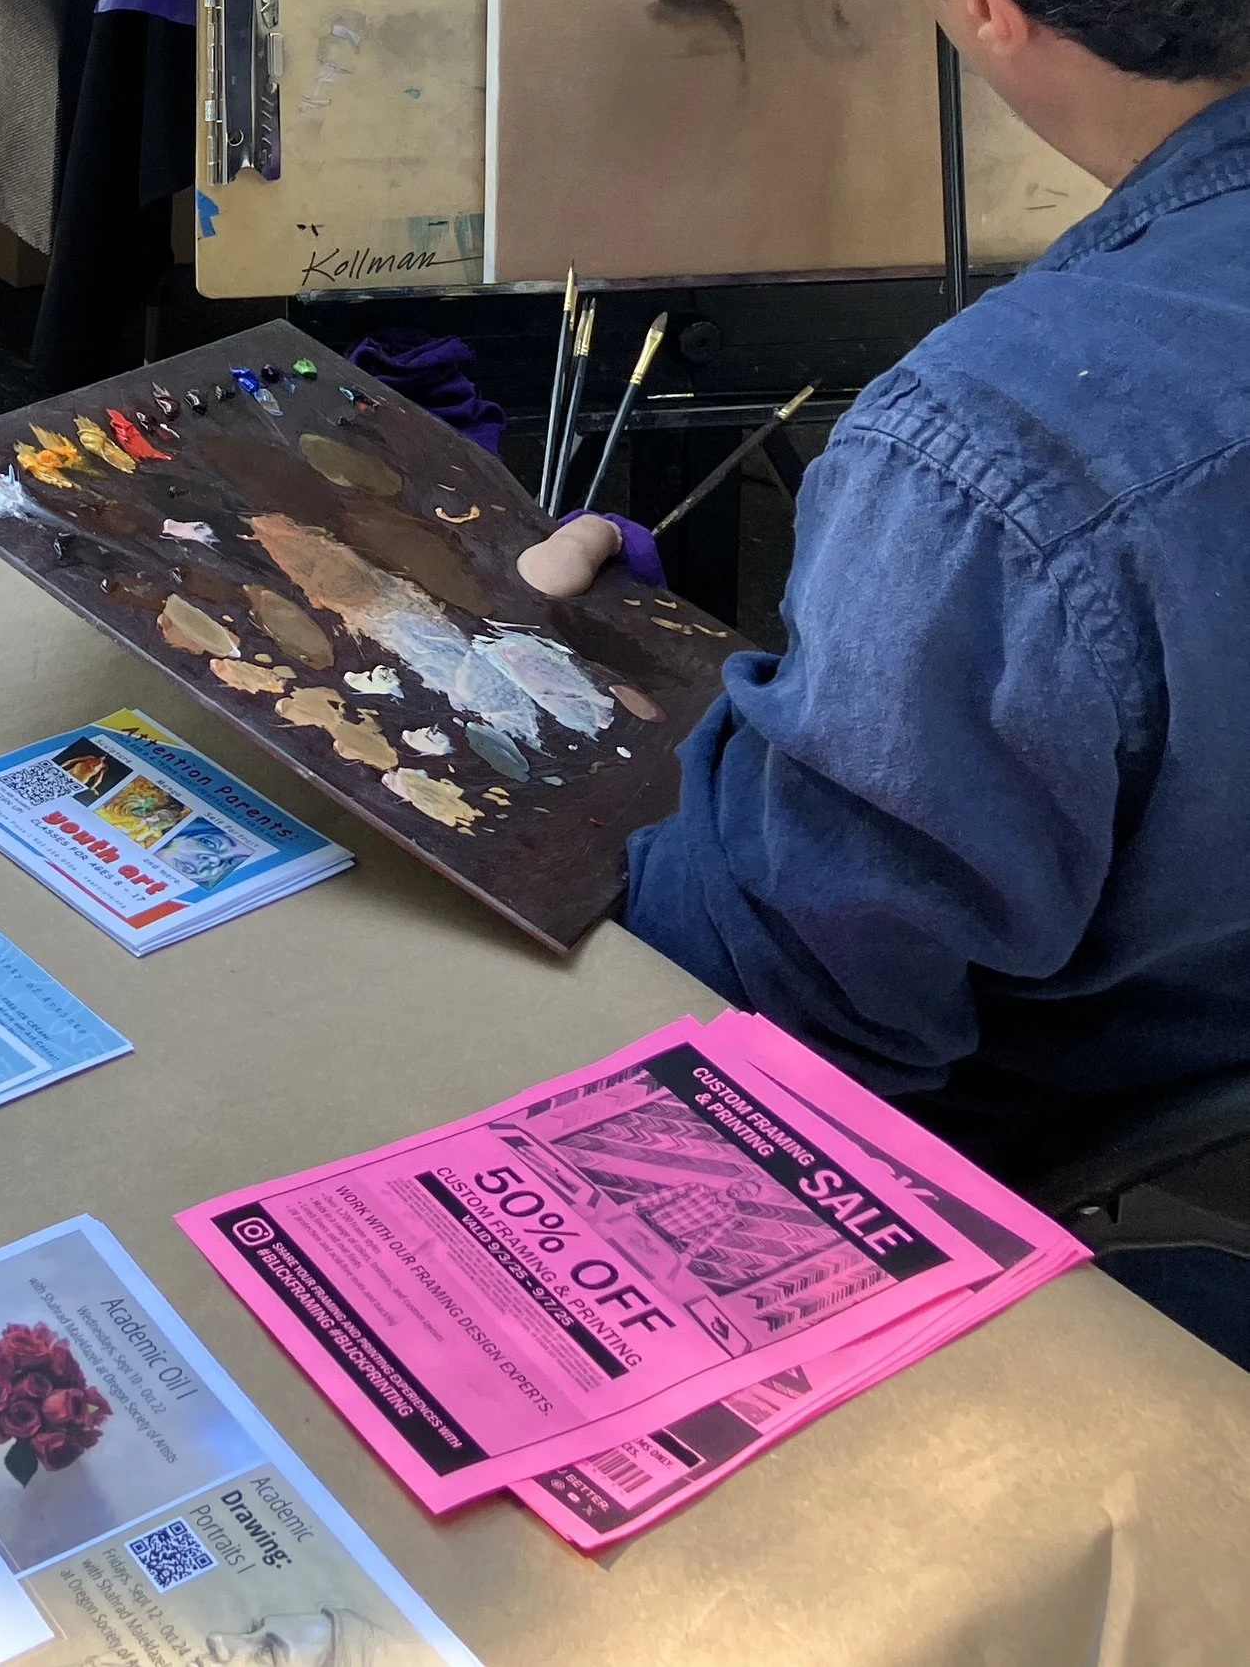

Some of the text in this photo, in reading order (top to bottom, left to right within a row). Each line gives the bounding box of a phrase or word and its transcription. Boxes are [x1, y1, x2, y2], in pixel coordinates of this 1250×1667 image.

[120, 725, 217, 785] Attention
[154, 779, 183, 797] Manga
[37, 808, 170, 896] youth art
[203, 812, 224, 824] Self
[29, 818, 70, 846] CLASSES
[67, 846, 89, 860] FOR
[87, 861, 115, 879] AGES
[130, 893, 145, 902] 17
[689, 1066, 817, 1167] CUSTOM FRAMING
[691, 1090, 778, 1157] & PRINTING
[468, 1161, 586, 1256] 50%
[562, 1254, 675, 1342] OFF
[791, 1167, 915, 1256] SALE
[27, 1276, 47, 1294] with
[334, 1185, 555, 1416] WORK WITH OUR FRAMING DESIGN EXPERTS.
[433, 1166, 644, 1367] CUSTOM FRAMING & PRINTING
[457, 1214, 576, 1327] VALID 9/3/25 9/7/25
[40, 1292, 71, 1324] Shahrad
[100, 1294, 172, 1368] Academic
[155, 1365, 190, 1391] Oil
[255, 1246, 415, 1417] #BLICKFRAMING #BLICKPRINTING
[270, 1241, 462, 1448] SHARE YOUR FRAMING AND PRINTING EXPERIENCES WITH
[71, 1305, 167, 1414] Wednesdays, Sept 10 Oct 22
[95, 1363, 110, 1375] at
[100, 1373, 132, 1404] Oregon
[122, 1402, 153, 1431] Society
[145, 1428, 160, 1439] of
[153, 1438, 179, 1463] Artists
[187, 1504, 251, 1566] Portraits
[214, 1489, 296, 1571] Drawing:
[249, 1475, 318, 1542] Academic
[59, 1568, 133, 1660] at Oregon Society of
[80, 1557, 133, 1619] with Shahrad
[99, 1548, 192, 1656] Fridays, Sept 12 Oct 24
